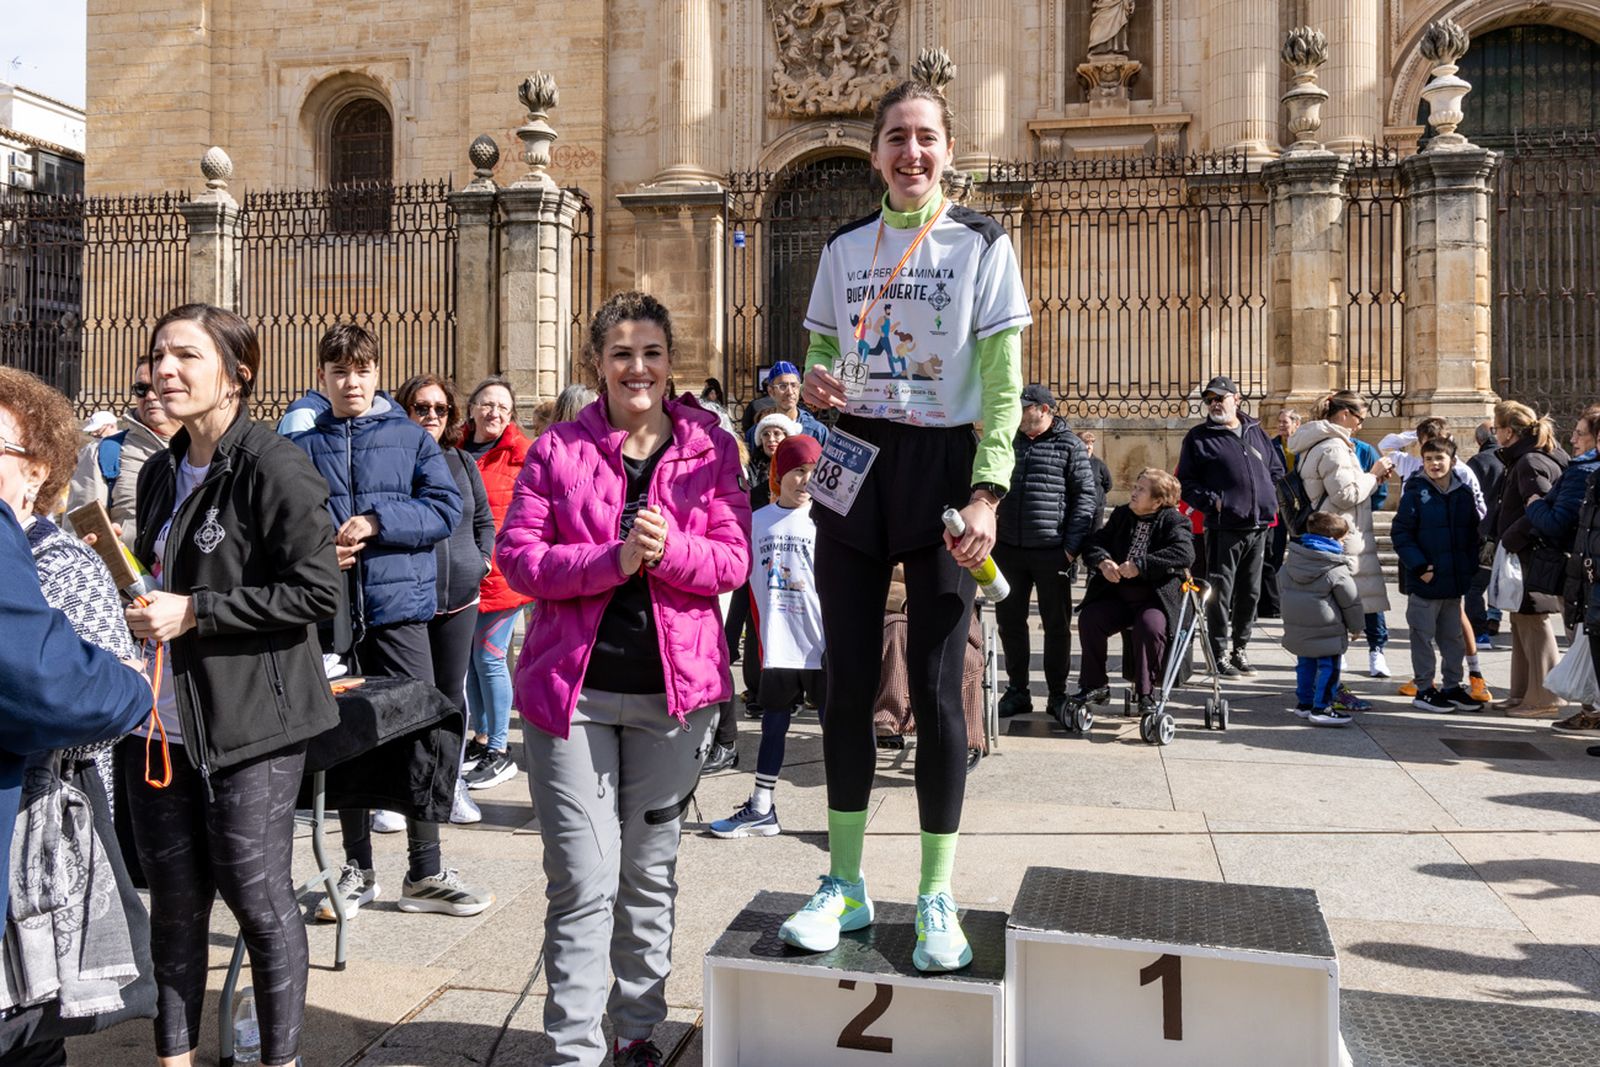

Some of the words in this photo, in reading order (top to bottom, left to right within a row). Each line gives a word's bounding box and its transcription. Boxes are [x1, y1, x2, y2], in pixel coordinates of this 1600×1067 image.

[847, 285, 874, 303] BUENA
[881, 284, 928, 301] MUERTE
[856, 268, 897, 280] CARRER
[900, 266, 954, 279] CAMINATA
[836, 979, 894, 1054] 2
[1140, 953, 1183, 1041] 1
